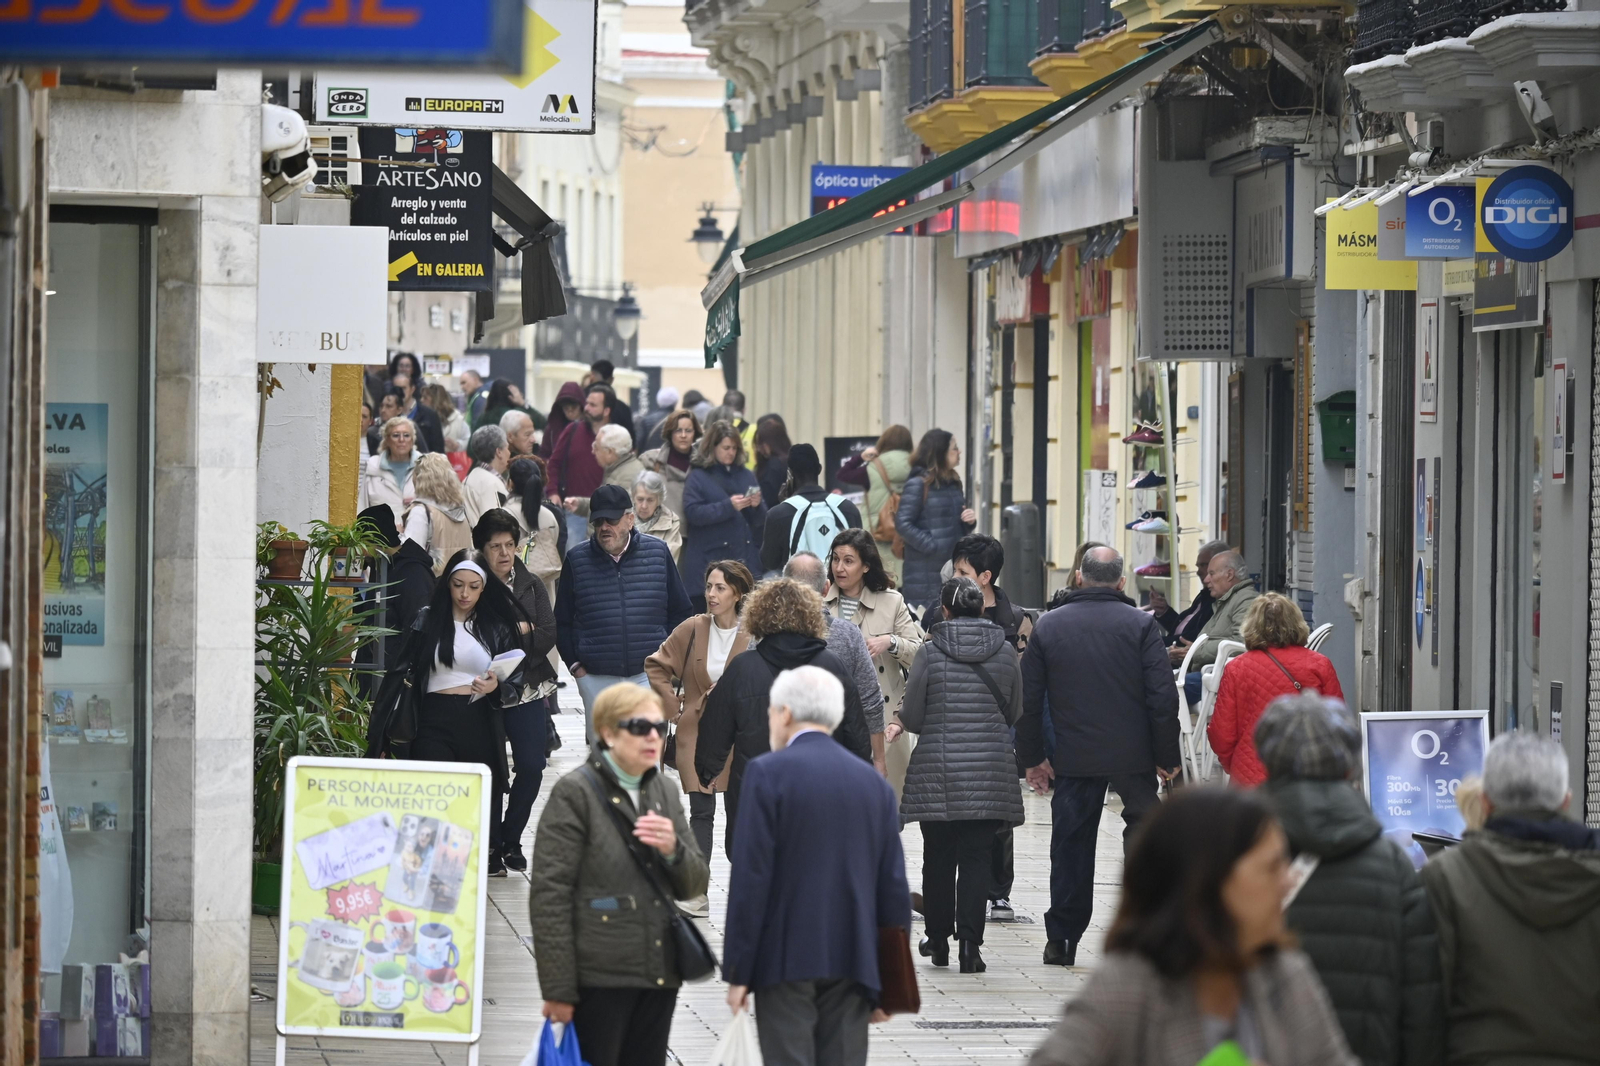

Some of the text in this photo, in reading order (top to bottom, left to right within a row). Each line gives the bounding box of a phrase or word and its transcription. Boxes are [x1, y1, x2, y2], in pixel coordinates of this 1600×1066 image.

[335, 104, 361, 112] CERO
[426, 99, 502, 112] EUROPAFM
[378, 155, 399, 168] EL
[815, 172, 858, 189] óptica
[391, 196, 467, 211] Arreglo y venta
[401, 212, 458, 225] del calzado
[1485, 206, 1568, 224] DIGI
[389, 229, 469, 244] Artículos en piel
[1337, 231, 1377, 247] MÁSM
[417, 263, 484, 277] EN GALERIA
[307, 778, 470, 798] PERSONALIZACIÓN
[327, 794, 449, 812] AL MOMENTO
[335, 888, 374, 915] 9,95€
